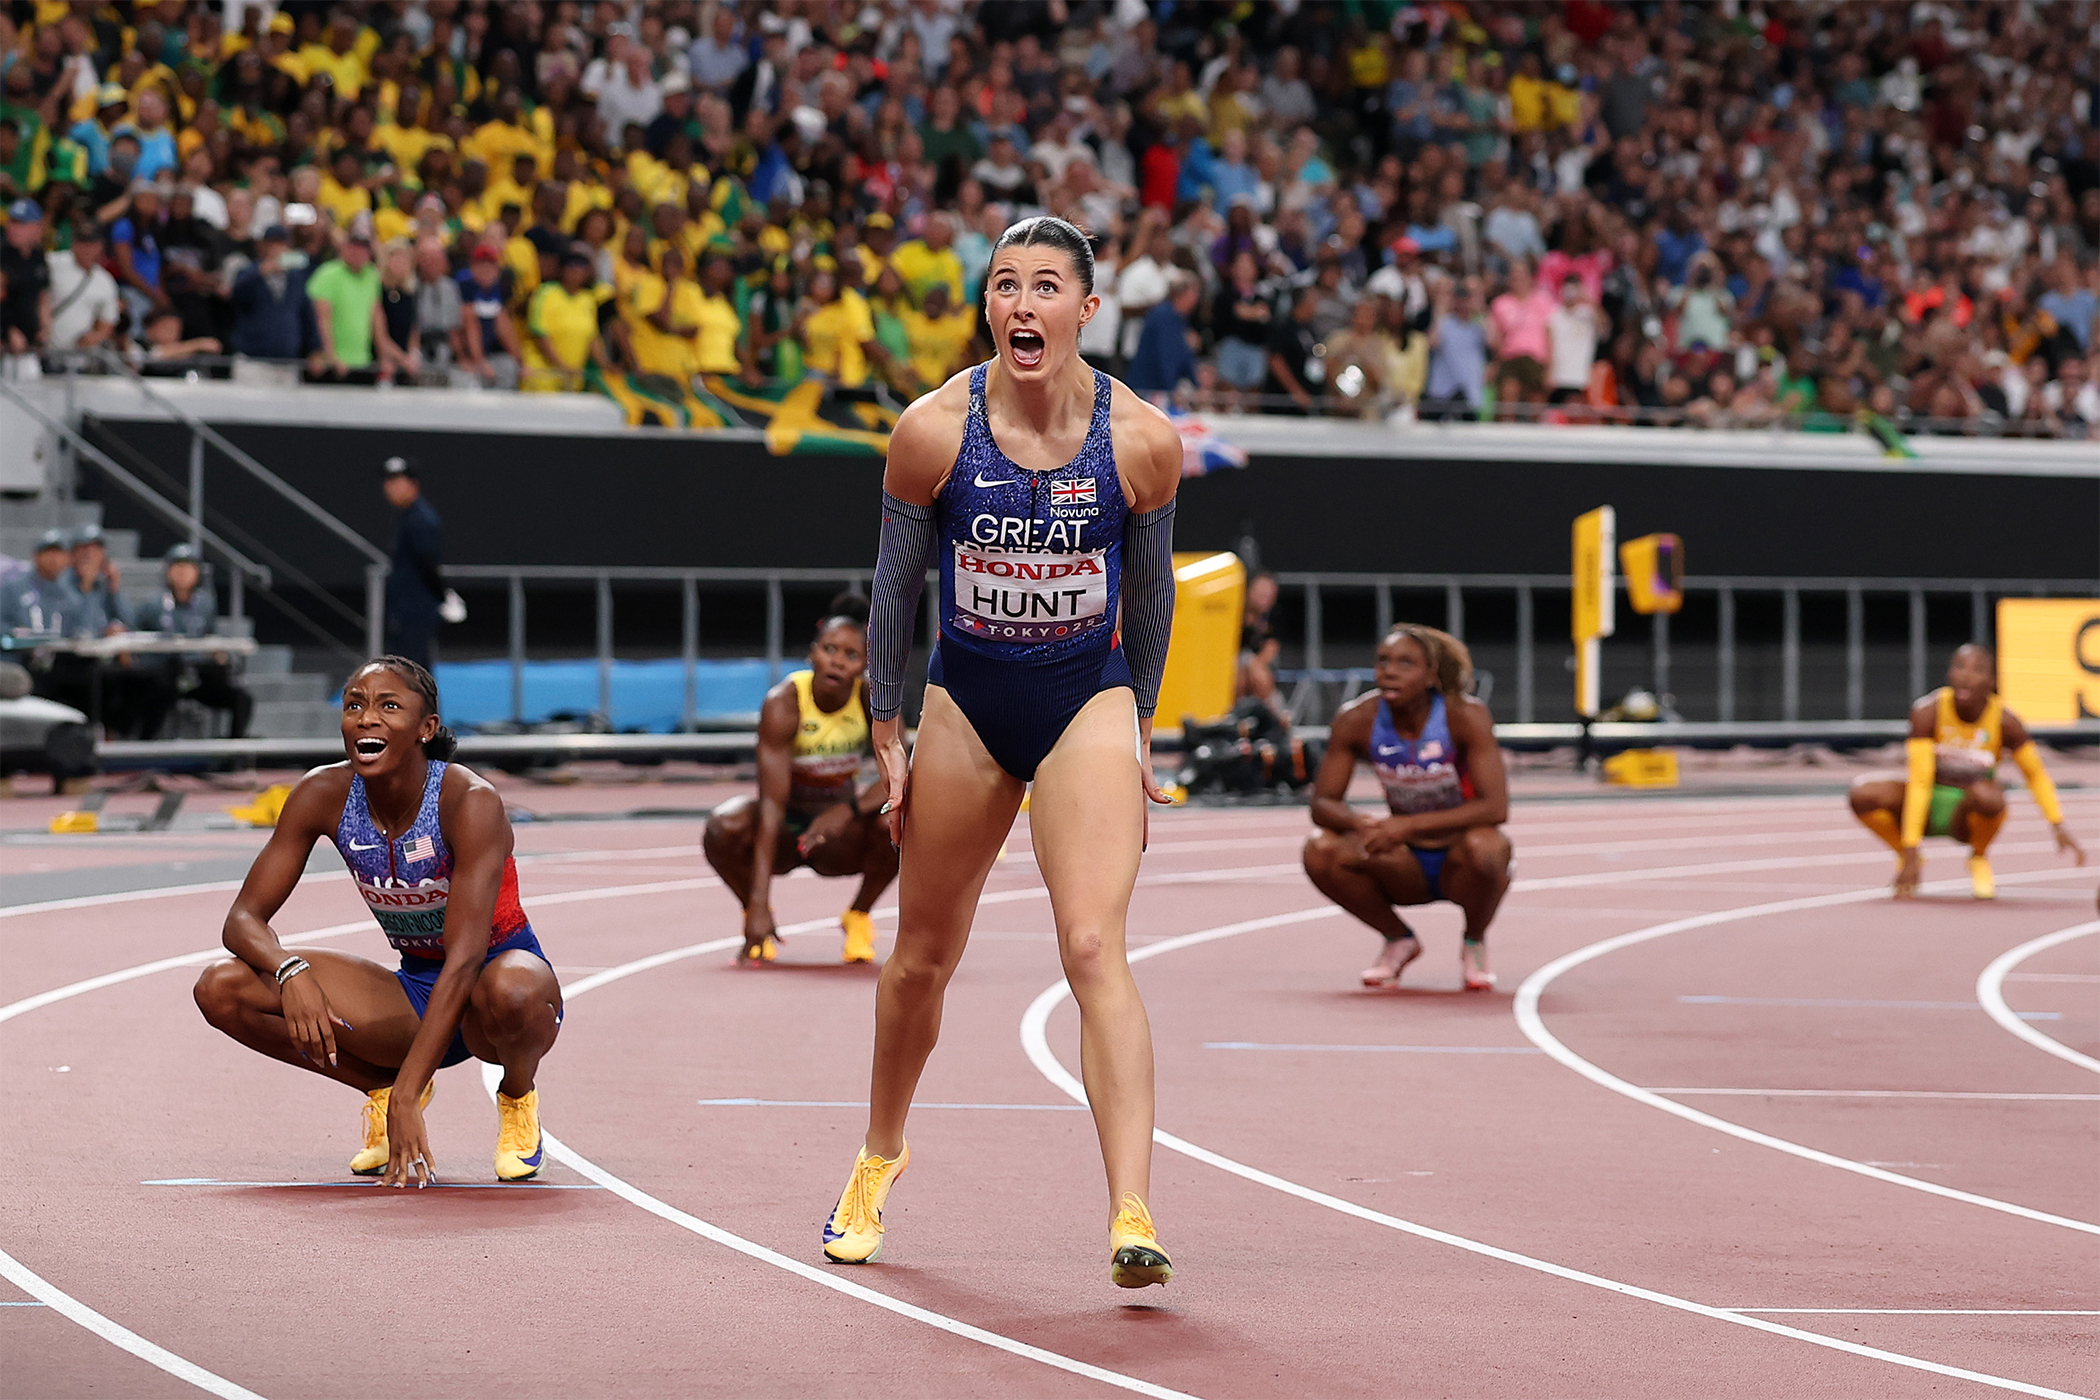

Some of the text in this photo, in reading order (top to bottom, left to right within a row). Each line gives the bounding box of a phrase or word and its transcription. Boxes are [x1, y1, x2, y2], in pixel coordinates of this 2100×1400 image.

[1050, 506, 1099, 518] Novuna
[971, 513, 1089, 548] GREAT
[957, 552, 1103, 580] HONDA
[972, 585, 1087, 618] HUNT
[359, 886, 448, 905] ONDA
